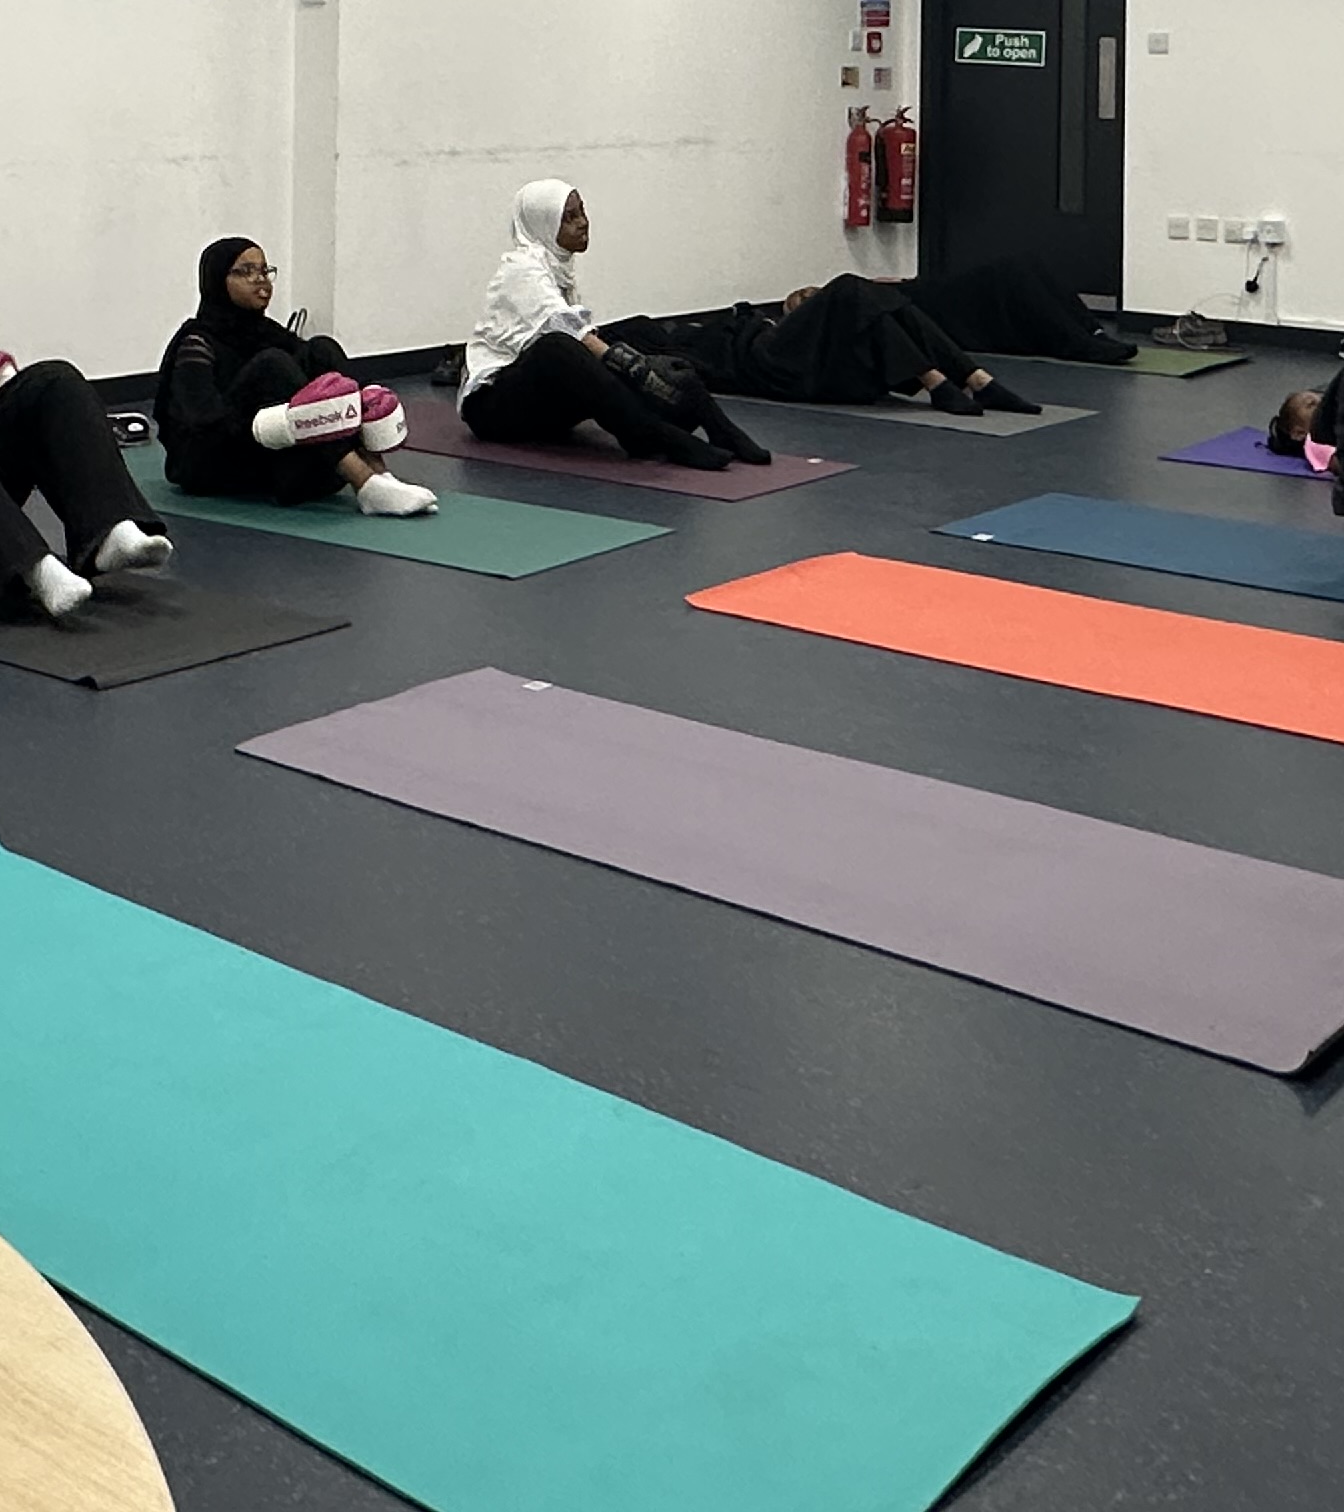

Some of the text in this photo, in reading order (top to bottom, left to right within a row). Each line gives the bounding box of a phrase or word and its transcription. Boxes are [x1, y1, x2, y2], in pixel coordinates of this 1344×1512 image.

[995, 33, 1030, 48] Push
[986, 44, 1037, 60] to open
[294, 409, 343, 430] Reebok
